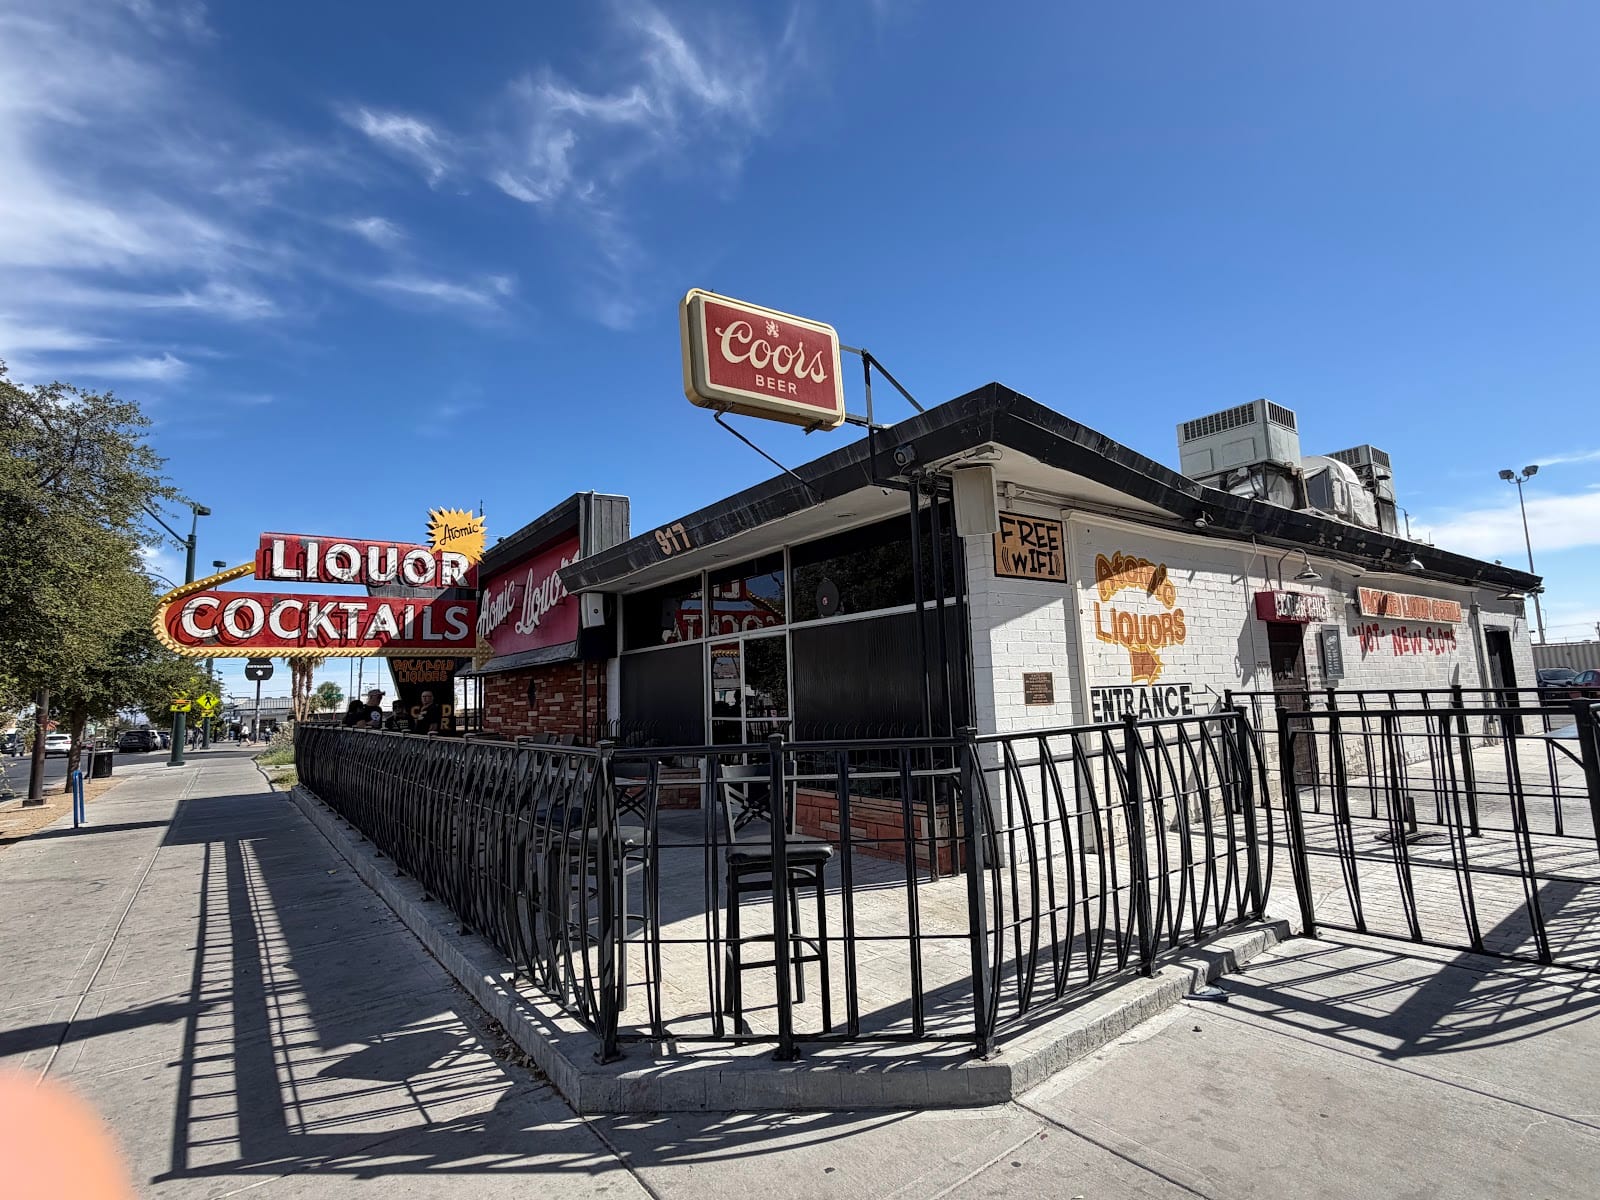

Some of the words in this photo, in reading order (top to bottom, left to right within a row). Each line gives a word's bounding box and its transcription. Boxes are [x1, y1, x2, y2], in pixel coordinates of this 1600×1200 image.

[715, 320, 828, 384] Coors
[755, 374, 798, 395] BEER
[654, 522, 692, 555] 917
[999, 516, 1059, 550] FREE
[272, 540, 469, 587] LIQUOR
[1012, 549, 1055, 576] WIFI
[181, 597, 470, 640] COCKTAILS
[1094, 601, 1187, 647] LIQUORS
[1391, 626, 1423, 656] NEW
[1426, 626, 1457, 655] SLOTS
[399, 670, 448, 684] LIQUORS
[1090, 685, 1193, 722] ENTRANCE
